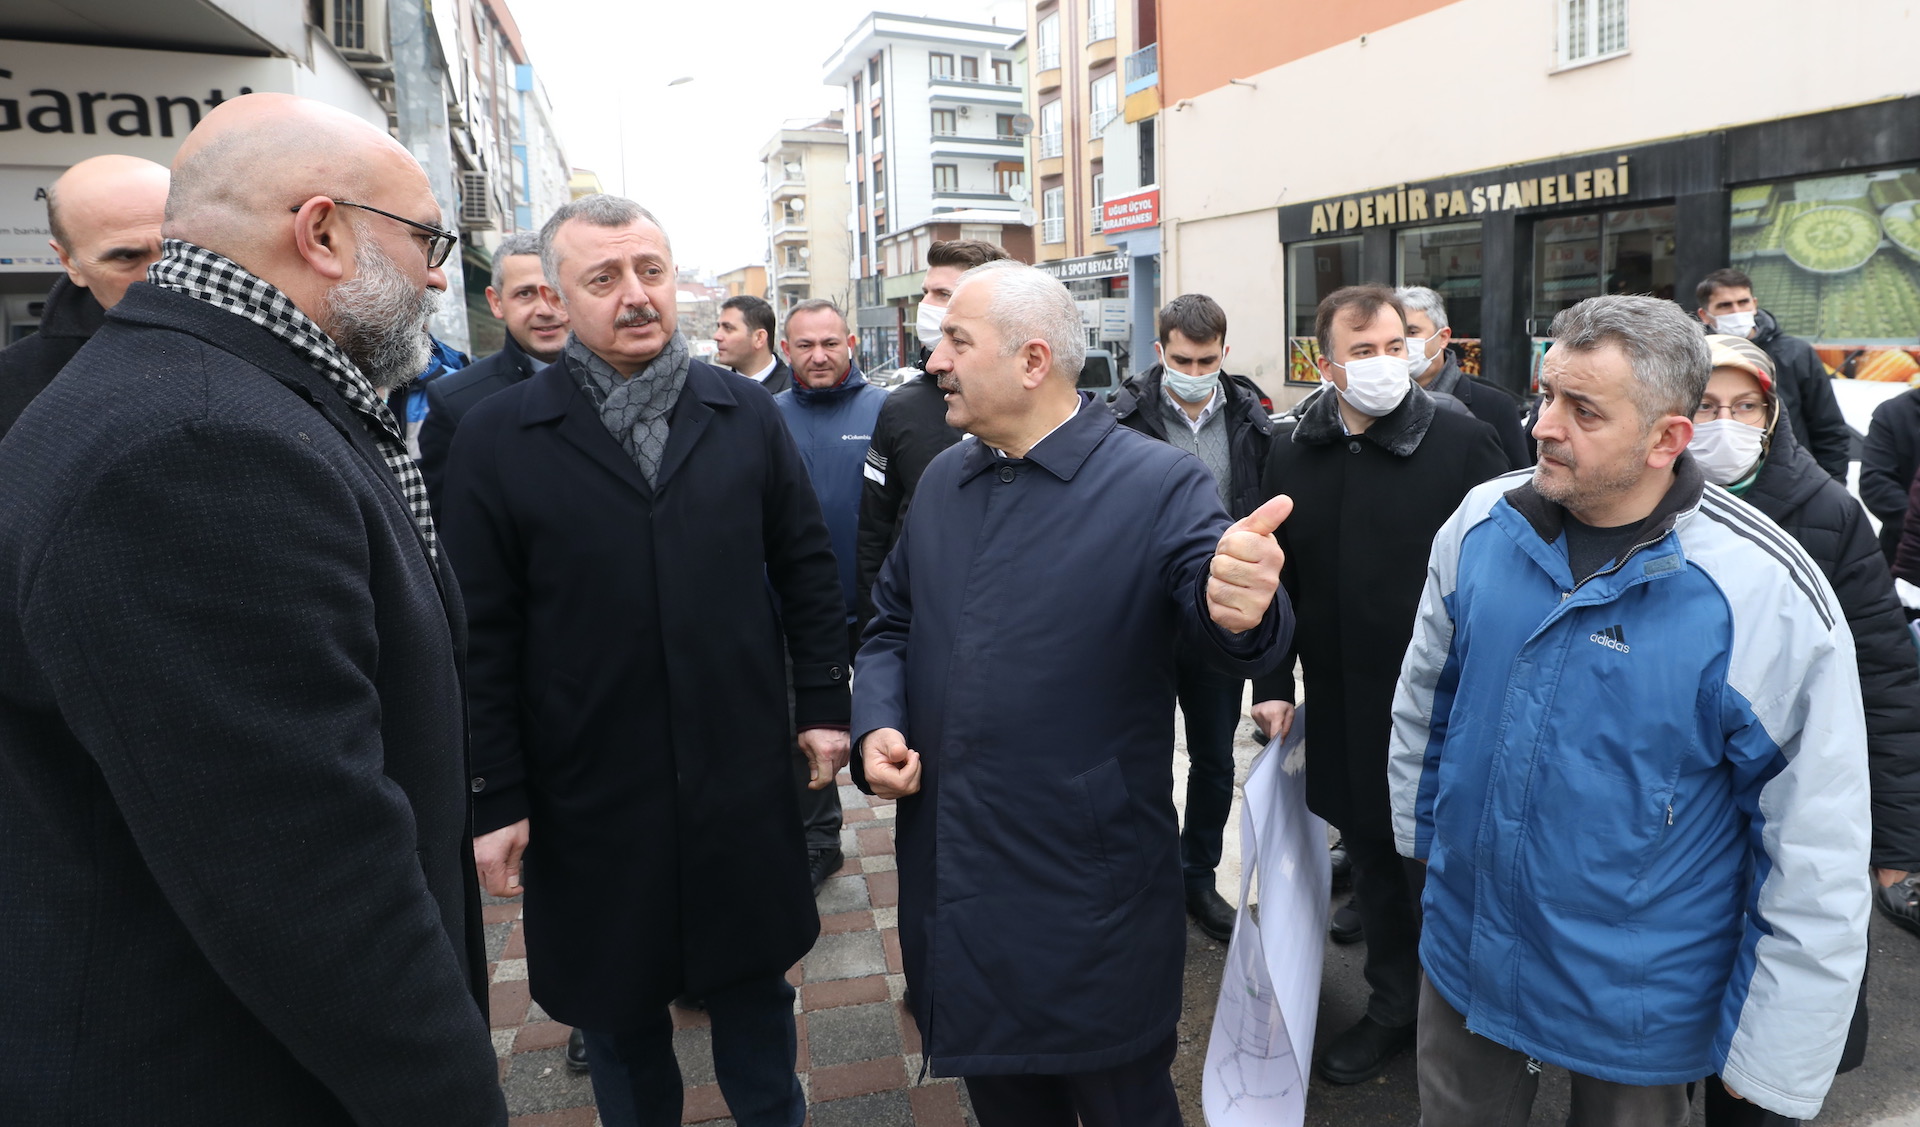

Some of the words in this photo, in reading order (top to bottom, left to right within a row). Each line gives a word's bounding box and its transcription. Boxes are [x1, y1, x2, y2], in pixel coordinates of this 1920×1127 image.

[0, 69, 252, 137] aran
[1108, 204, 1128, 216] UĞUR
[1129, 199, 1153, 213] ÜÇYOL
[1310, 184, 1428, 234] AYDEMİR
[1060, 264, 1068, 277] &
[1068, 261, 1087, 276] SPOT
[1087, 259, 1112, 274] BEYAZ
[1590, 633, 1630, 653] adidas
